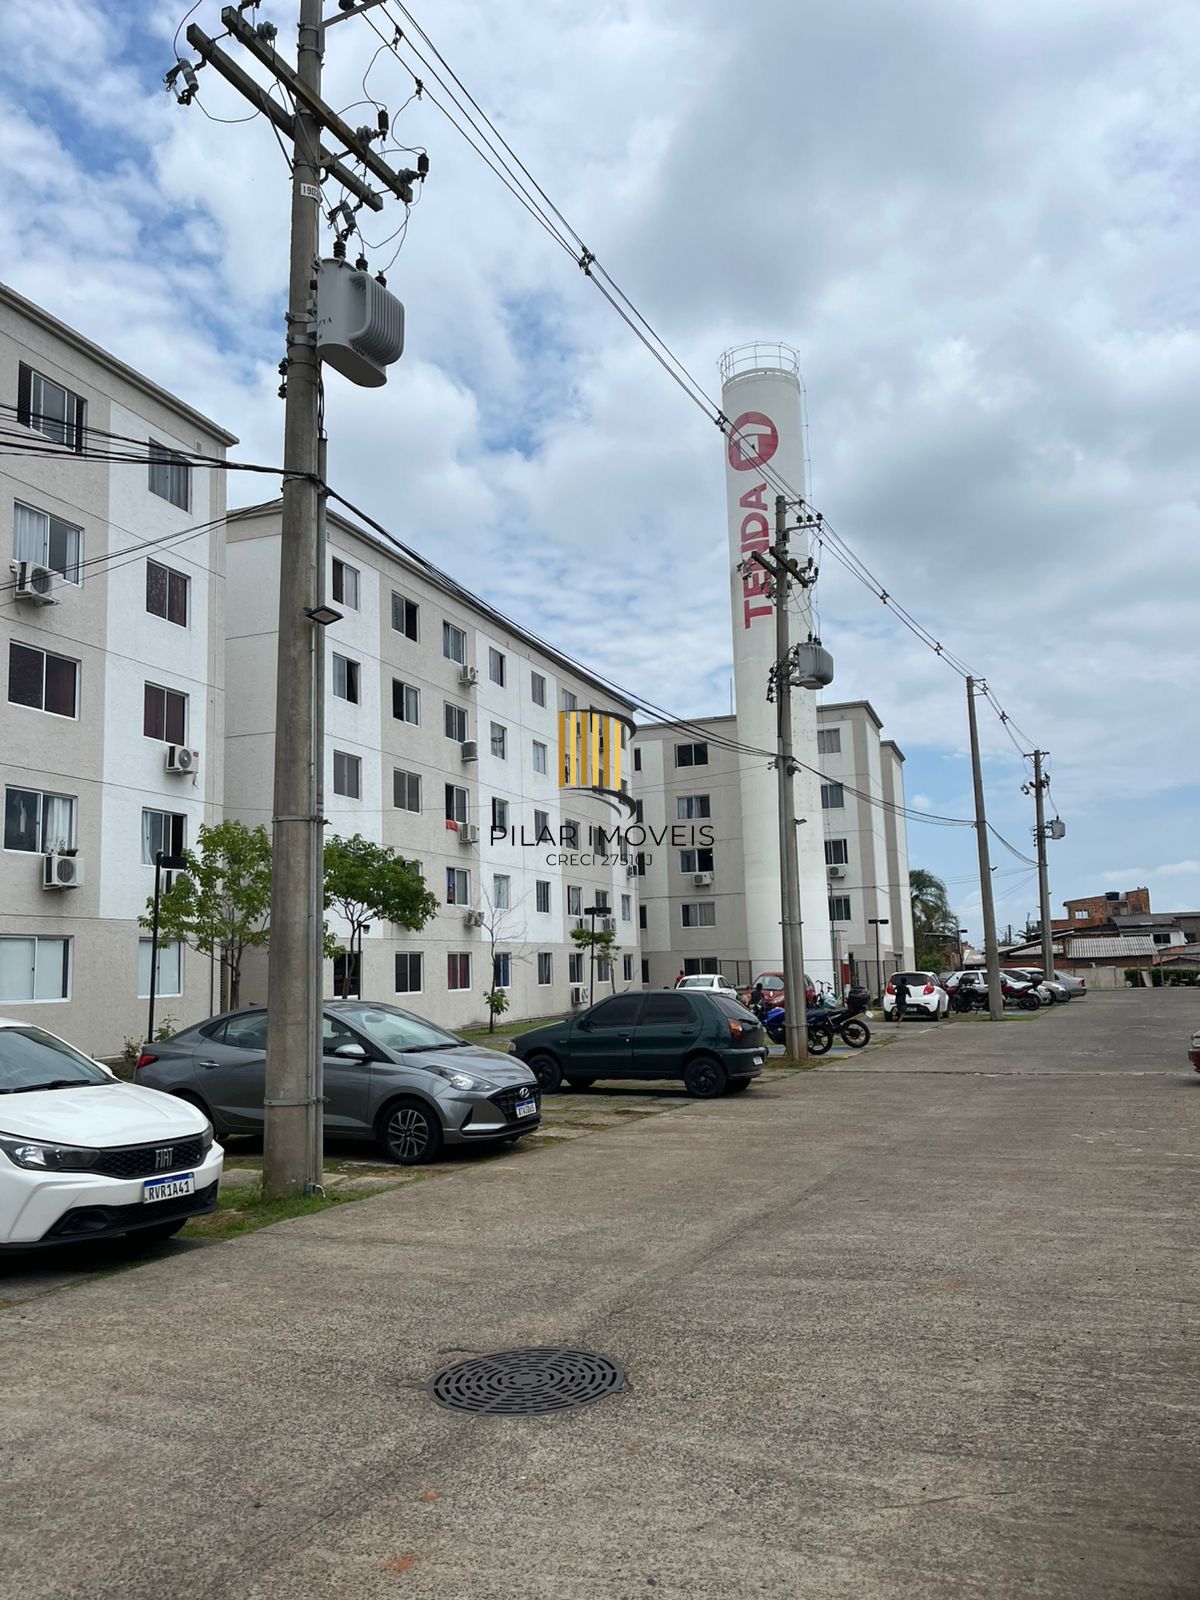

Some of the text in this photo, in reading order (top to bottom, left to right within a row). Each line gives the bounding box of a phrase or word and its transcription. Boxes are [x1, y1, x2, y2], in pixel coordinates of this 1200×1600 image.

[739, 483, 773, 629] TENDA
[155, 1147, 174, 1168] FIAT
[148, 1180, 190, 1200] RVR1A41
